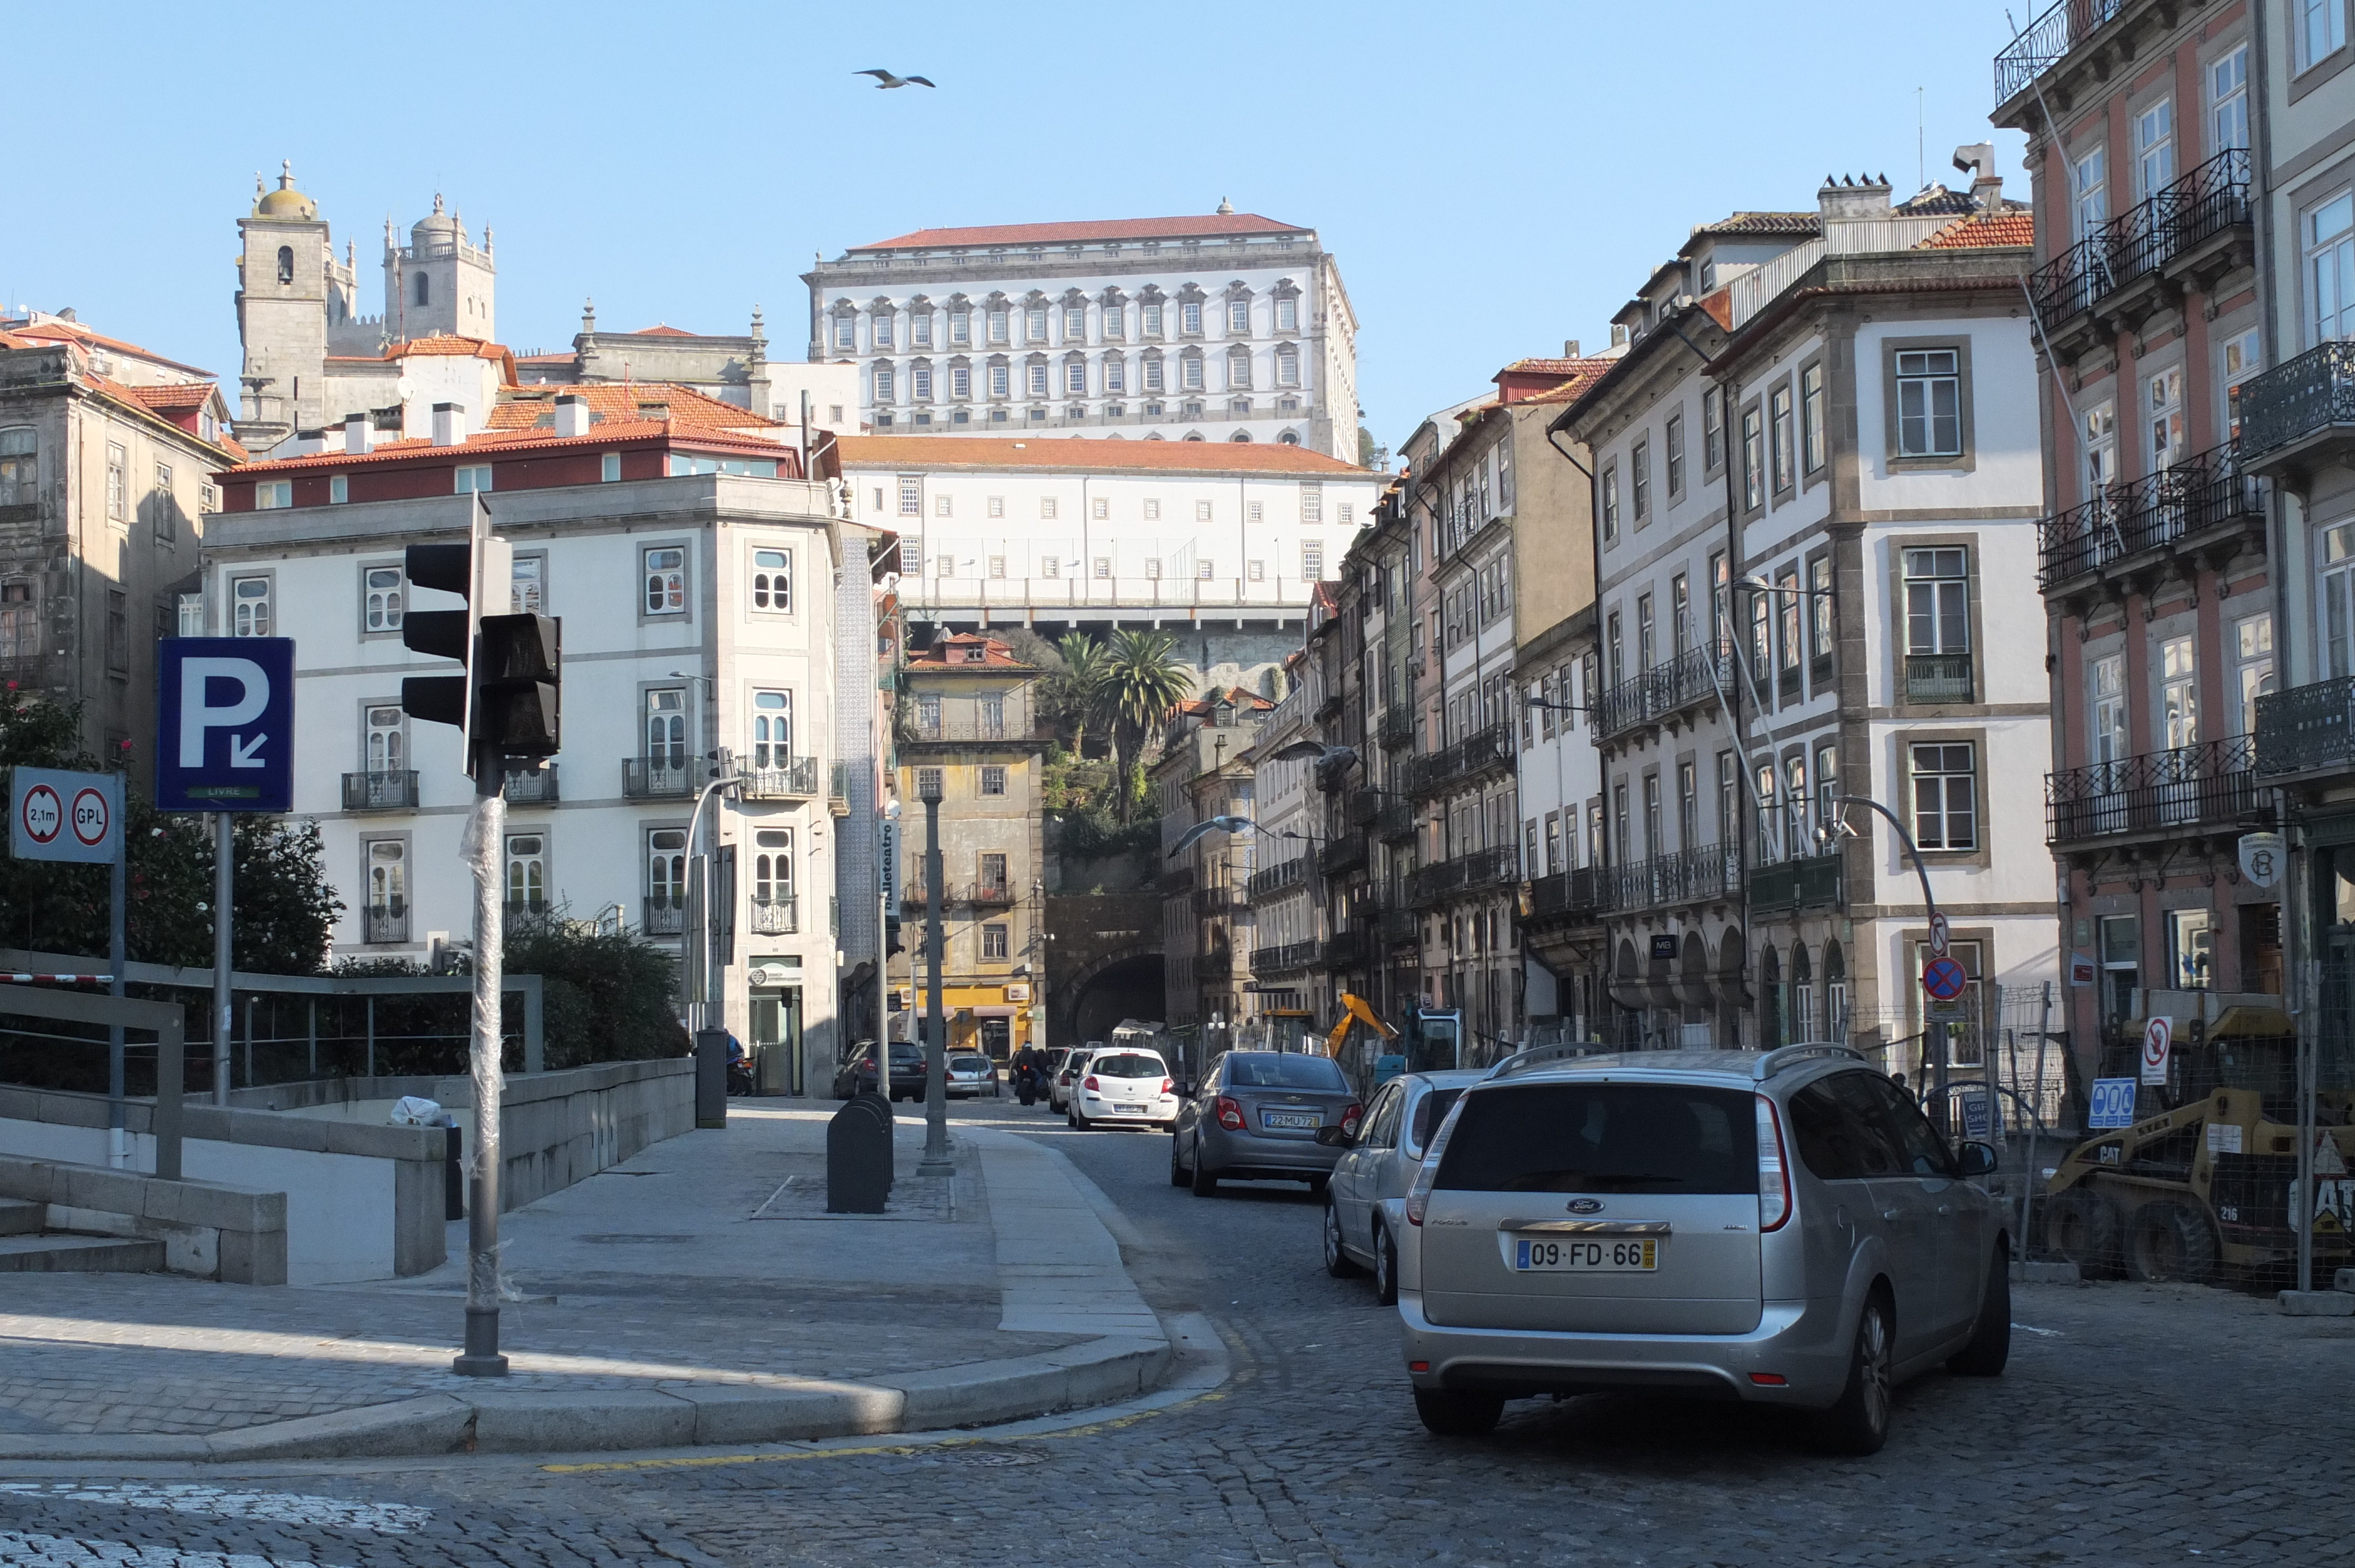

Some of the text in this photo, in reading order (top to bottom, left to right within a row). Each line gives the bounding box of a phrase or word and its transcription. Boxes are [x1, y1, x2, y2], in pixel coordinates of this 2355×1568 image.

[179, 656, 270, 768] P
[208, 787, 241, 795] LIVRE
[30, 808, 55, 823] 2,1m
[77, 808, 103, 825] GPL
[1968, 1102, 1987, 1112] GIF
[2099, 1145, 2120, 1165] CAT
[1574, 1200, 1594, 1210] Ford
[2220, 1207, 2238, 1221] 216
